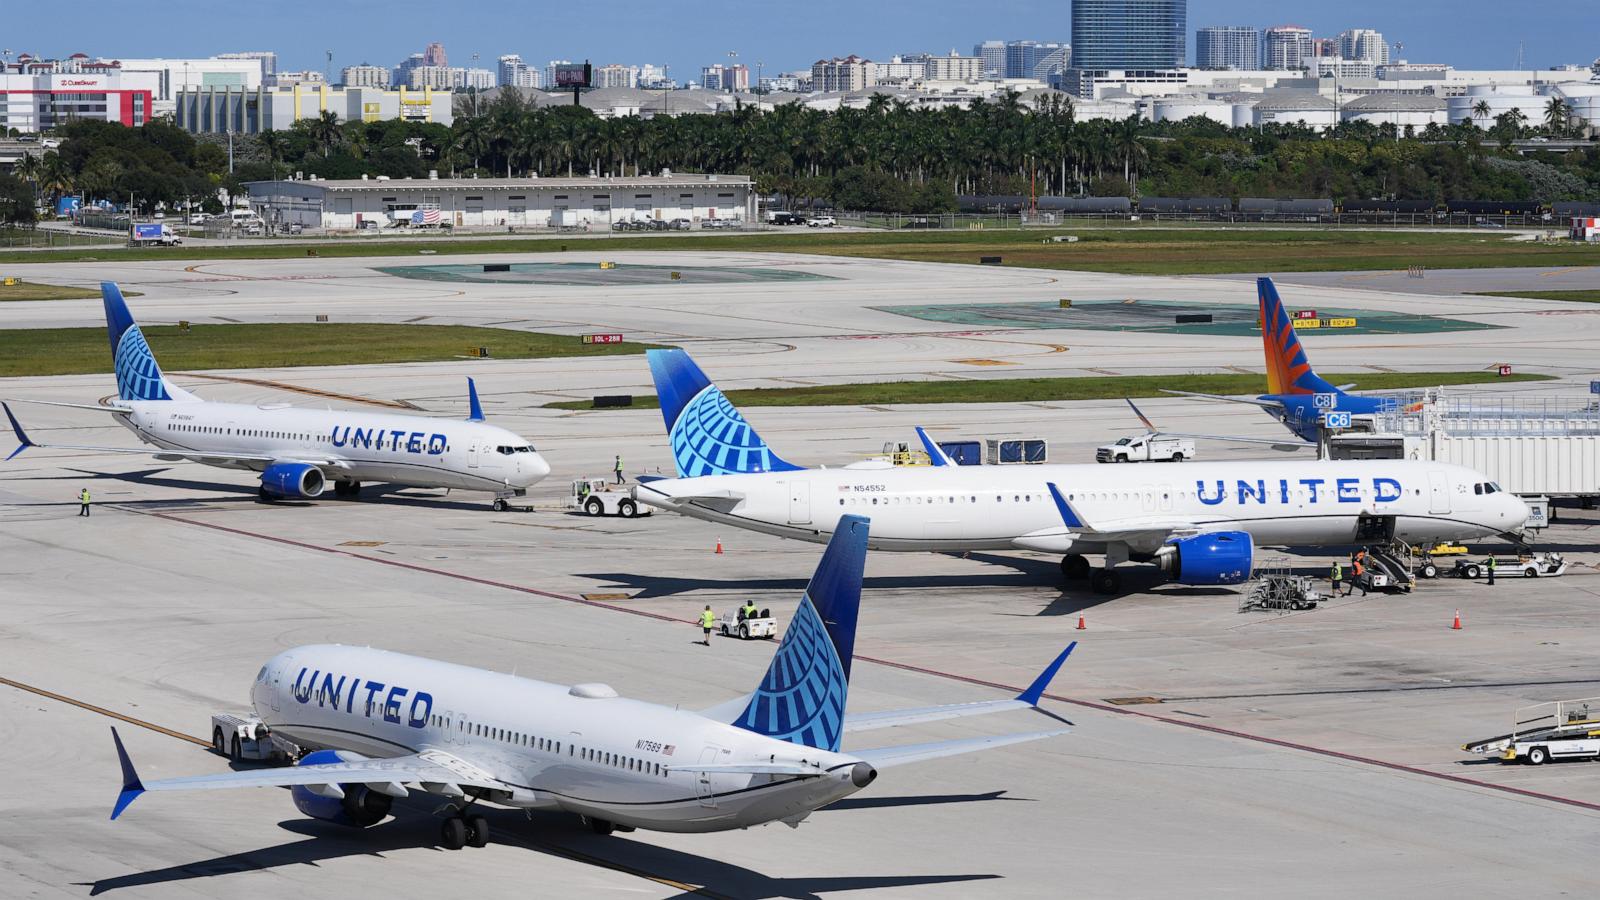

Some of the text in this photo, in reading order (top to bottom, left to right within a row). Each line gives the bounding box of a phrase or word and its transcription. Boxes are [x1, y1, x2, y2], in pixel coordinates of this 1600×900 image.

[1315, 395, 1331, 407] C8
[1329, 414, 1348, 426] C6
[331, 425, 448, 456] UNITED
[1196, 478, 1402, 506] UNITED
[294, 667, 434, 730] UNITED
[635, 738, 662, 753] N17589
